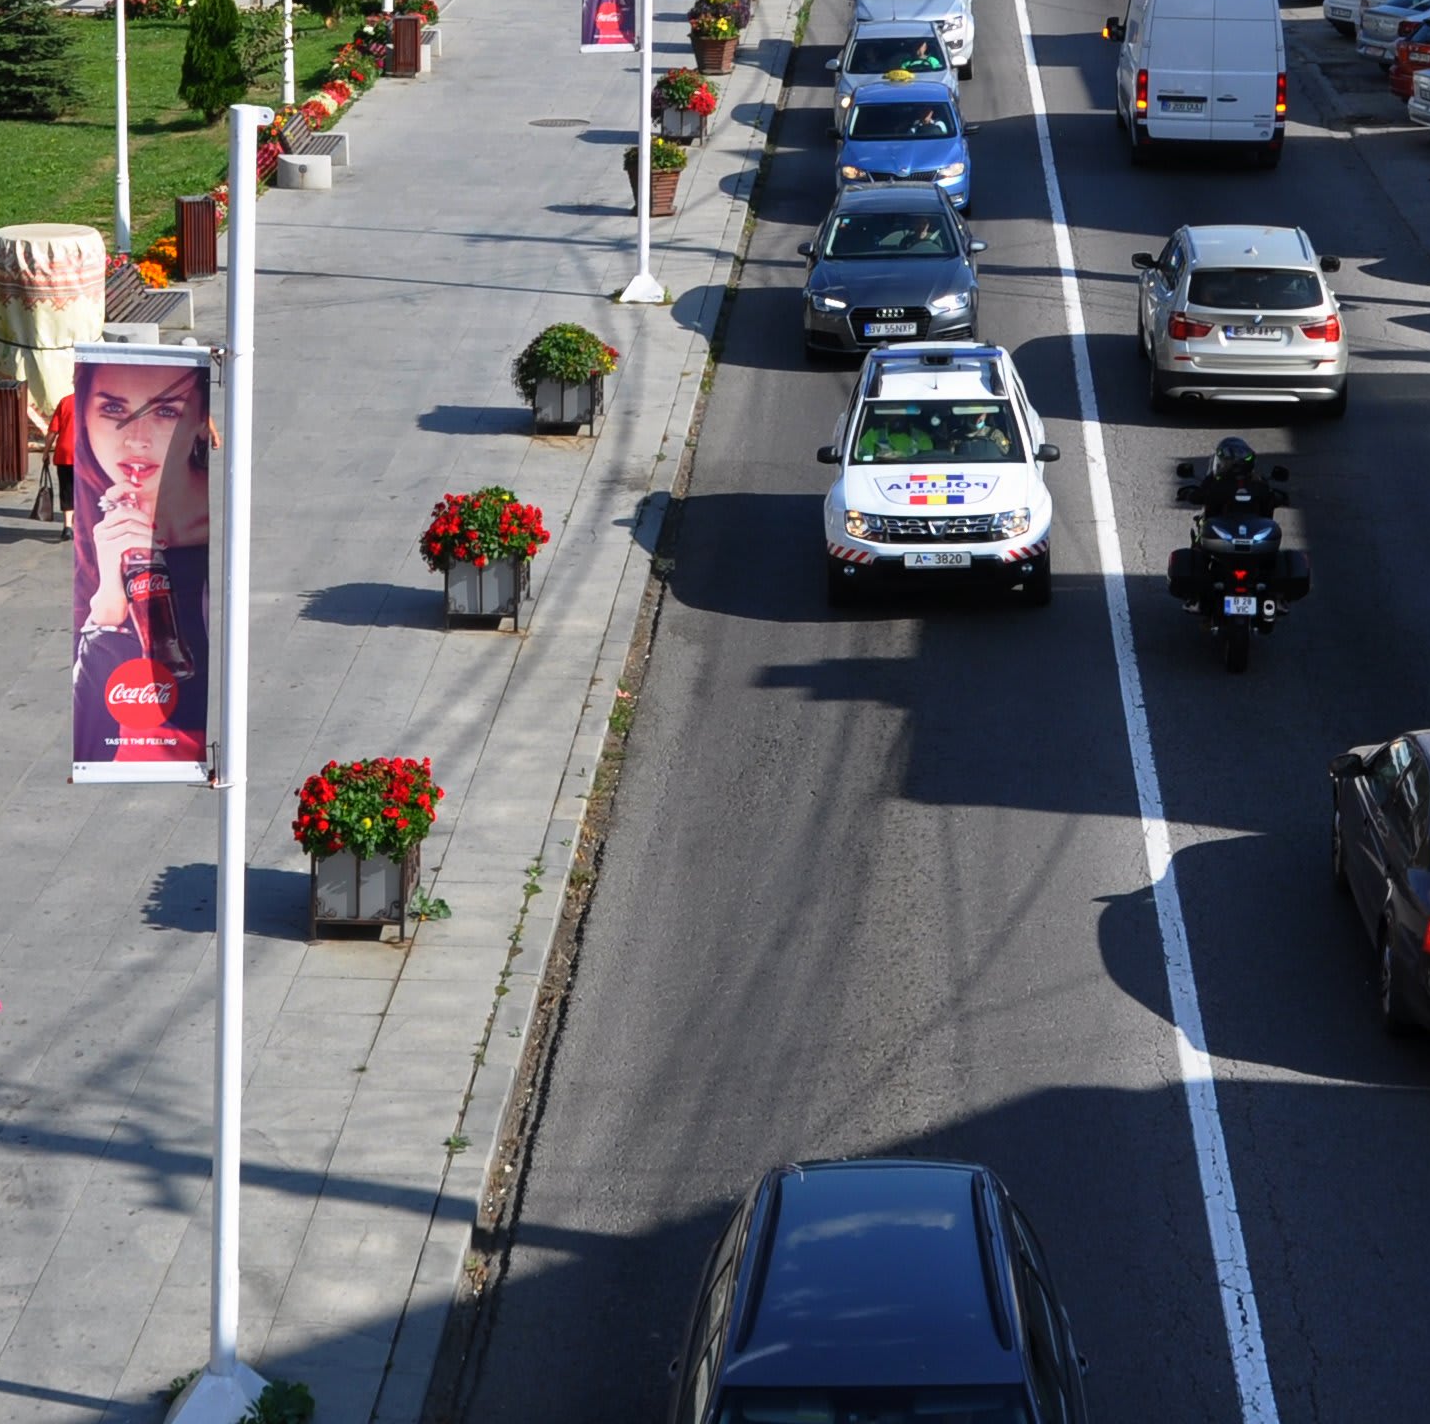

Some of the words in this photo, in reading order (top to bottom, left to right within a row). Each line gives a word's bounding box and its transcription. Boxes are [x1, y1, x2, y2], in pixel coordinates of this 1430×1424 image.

[934, 553, 963, 564] 3820
[126, 573, 171, 598] Coca-Cola
[108, 682, 174, 705] Coca-Cola
[105, 738, 128, 746] TASTE
[146, 738, 177, 746] FEELING
